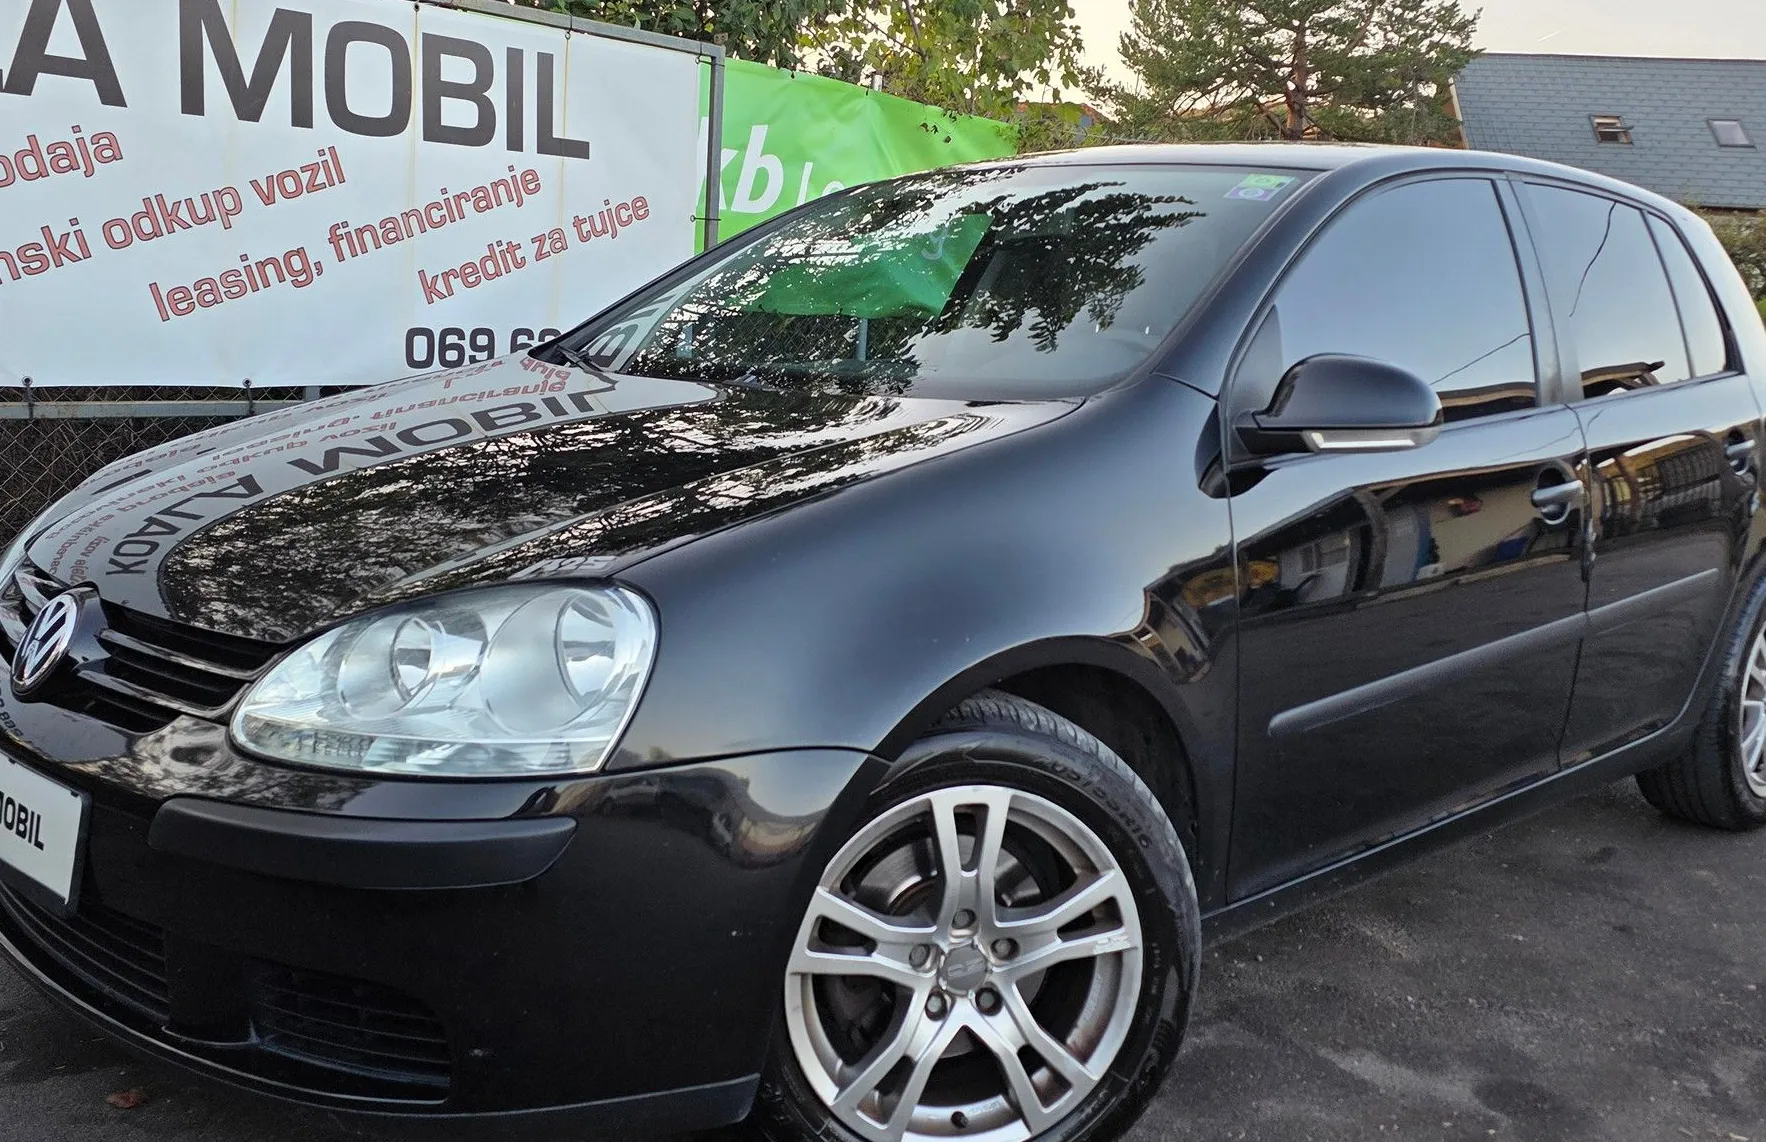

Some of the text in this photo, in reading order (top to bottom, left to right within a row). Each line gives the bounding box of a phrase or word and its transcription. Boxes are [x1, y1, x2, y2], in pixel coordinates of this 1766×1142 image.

[0, 0, 591, 160] A MOBIL
[102, 187, 243, 250] odkup
[249, 146, 346, 206] vozil
[149, 165, 541, 322] leasing, financiranje
[418, 196, 650, 305] kredit za tujce
[405, 327, 495, 369] 069
